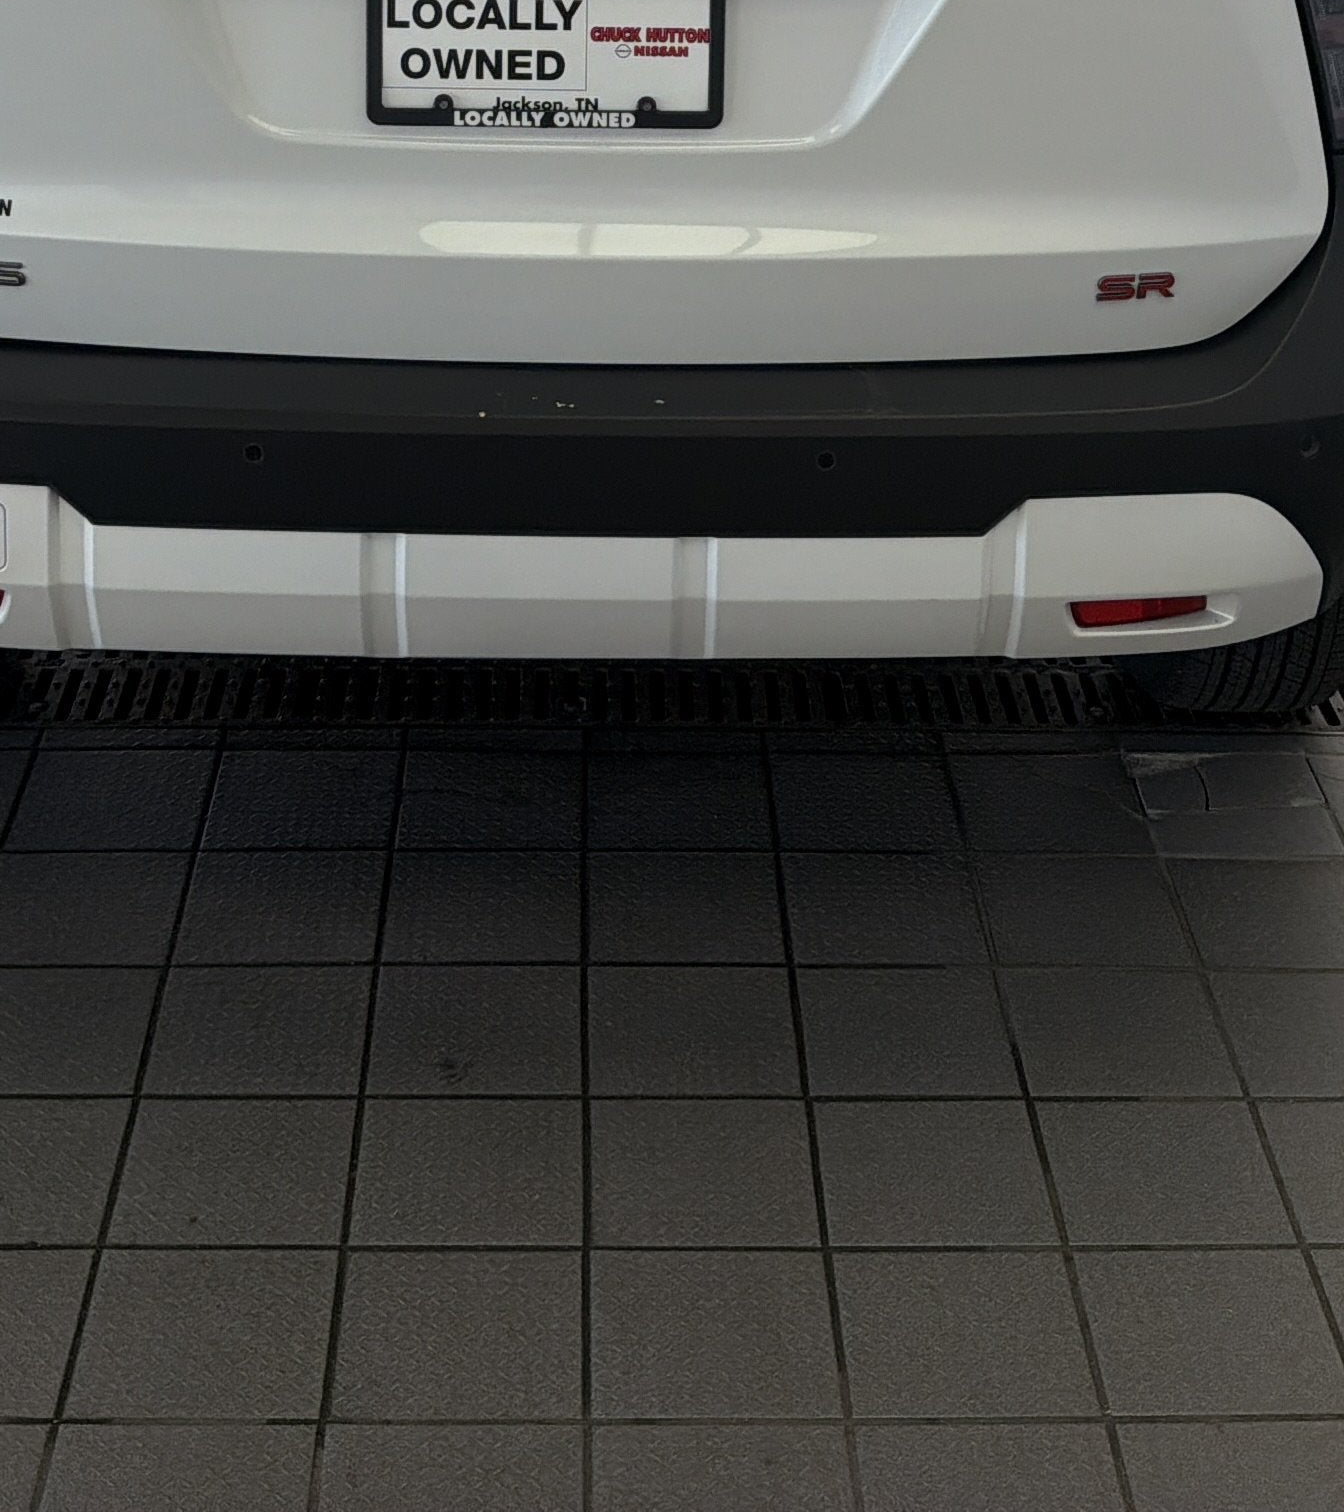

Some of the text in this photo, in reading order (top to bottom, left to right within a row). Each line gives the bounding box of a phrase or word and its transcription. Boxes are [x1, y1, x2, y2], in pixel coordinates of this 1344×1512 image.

[590, 26, 711, 44] CHUCK HUTTON
[634, 45, 689, 57] NISSAN
[400, 48, 565, 81] OWNED
[575, 98, 599, 111] TN
[453, 110, 636, 128] LOCALLY OWNED
[1095, 271, 1175, 302] SR
